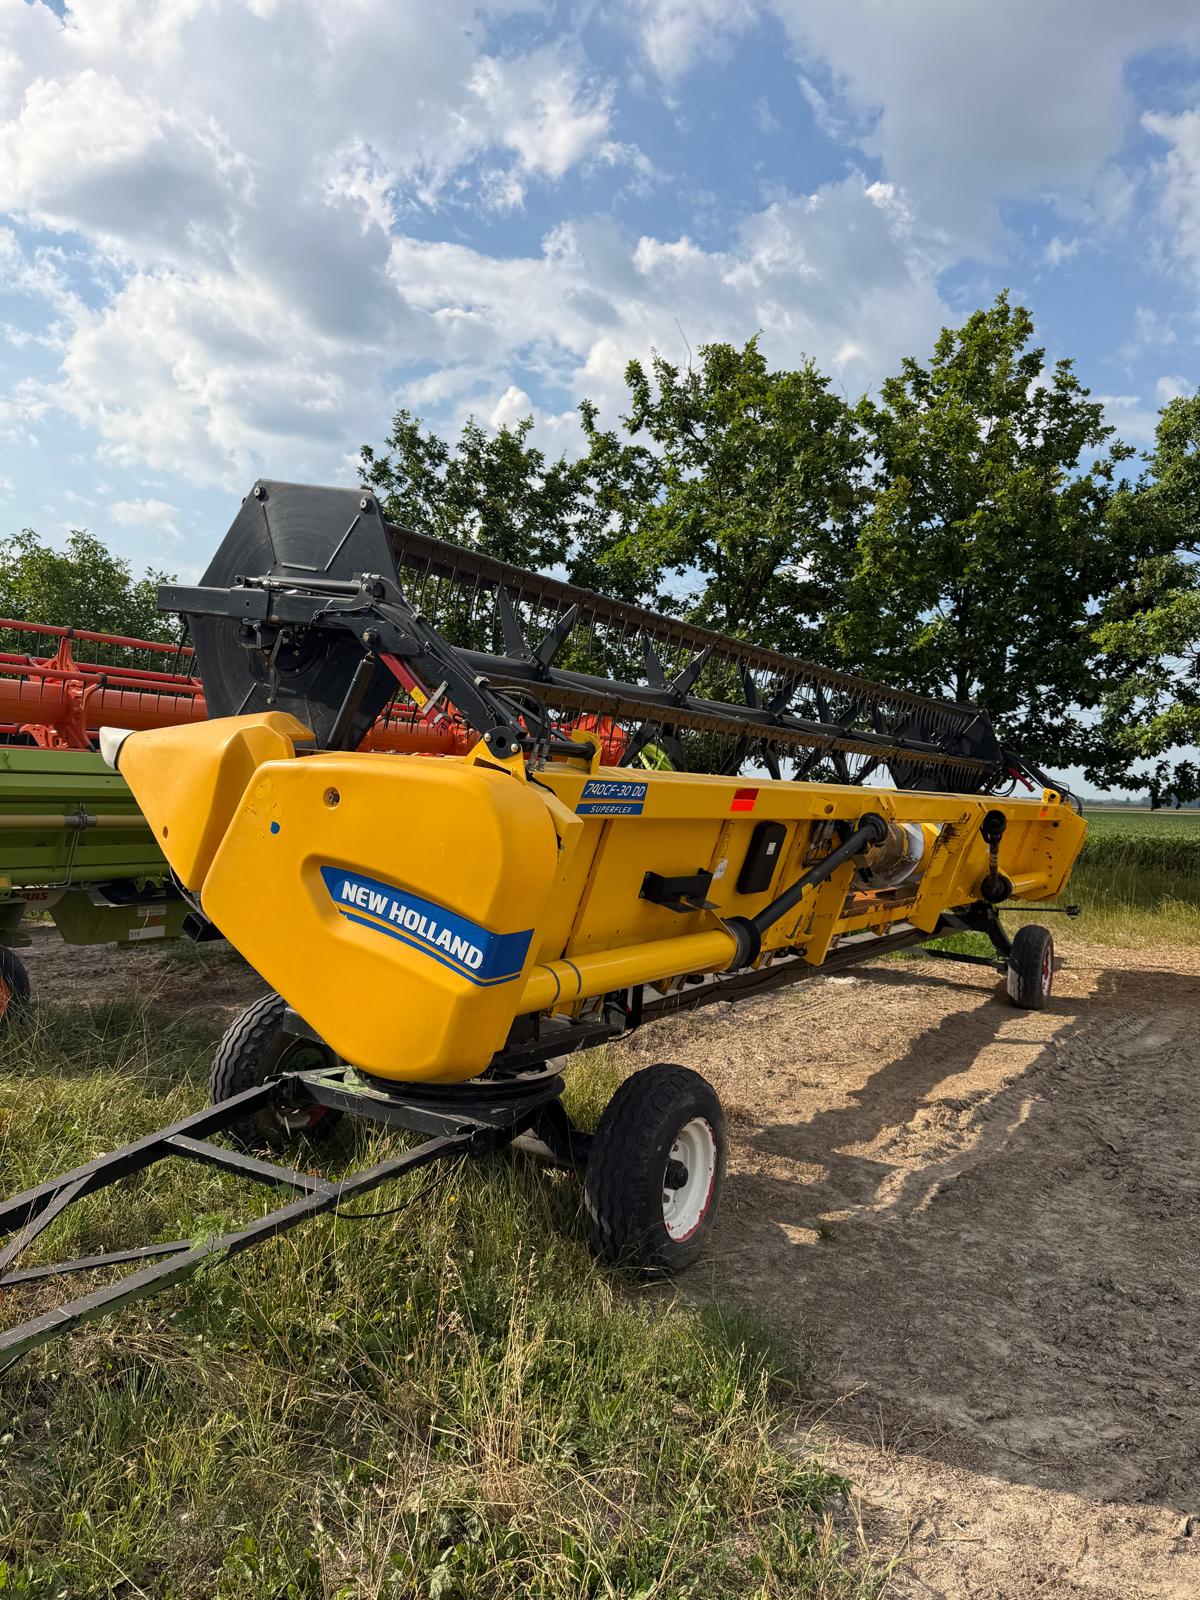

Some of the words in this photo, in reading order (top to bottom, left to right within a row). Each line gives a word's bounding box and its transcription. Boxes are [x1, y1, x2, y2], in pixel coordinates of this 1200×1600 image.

[584, 783, 632, 797] 740CF-30
[631, 786, 646, 797] DD
[590, 805, 632, 814] SUPERFLEX
[341, 881, 388, 914] NEW
[389, 901, 484, 970] HOLLAND
